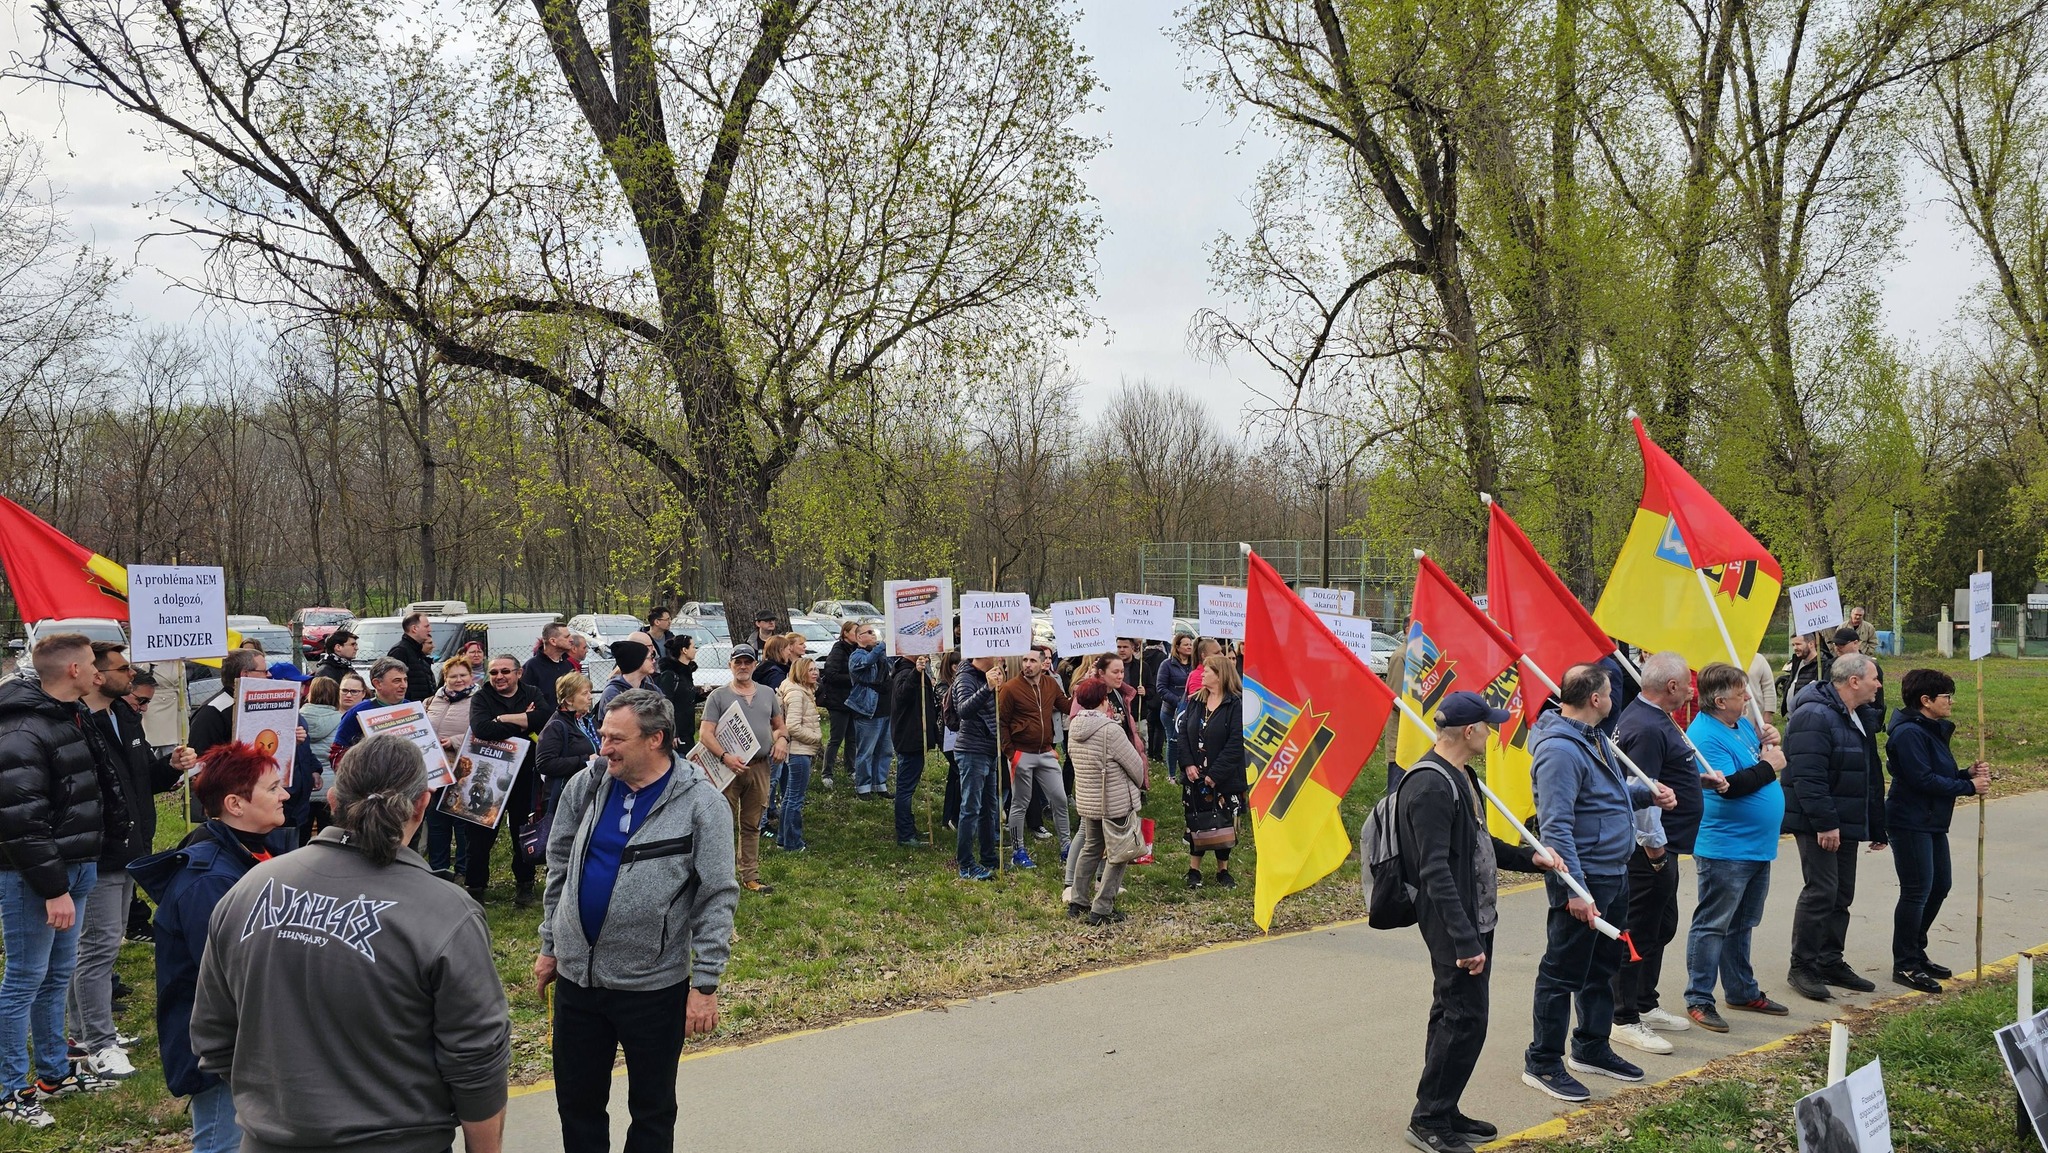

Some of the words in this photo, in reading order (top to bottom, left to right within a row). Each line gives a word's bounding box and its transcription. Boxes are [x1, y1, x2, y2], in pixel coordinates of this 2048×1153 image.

[135, 574, 142, 585] A
[145, 573, 194, 588] probléma
[196, 574, 217, 585] NEM
[1793, 582, 1834, 599] NÉLKÜLÜNK
[153, 596, 160, 605] a
[162, 593, 203, 607] dolgozó,
[974, 601, 980, 609] A
[981, 598, 1020, 609] LOJALITÁS
[1124, 597, 1164, 607] TISZTELET
[1209, 599, 1243, 608] MOTIVÁCIÓ
[1804, 599, 1828, 612] NINCS
[1075, 604, 1101, 615] NINCS
[1132, 608, 1149, 616] NEM
[1203, 608, 1229, 617] hiányzik,
[158, 613, 193, 625] hanem
[195, 615, 201, 623] a
[986, 612, 1009, 622] NEM
[1807, 614, 1829, 628] GYÁR!
[1209, 618, 1243, 628] tisztességes
[973, 624, 1022, 636] EGYIRÁNYÚ
[1073, 628, 1100, 639] NINCS
[147, 632, 213, 649] RENDSZER
[986, 639, 1010, 648] UTCA
[1070, 639, 1106, 650] lelkesedés!
[278, 701, 292, 709] MÁR?
[733, 713, 742, 725] MIT
[739, 724, 754, 744] KÍVÁN
[479, 746, 504, 759] FÉLNI
[277, 929, 329, 947] HUNGARY
